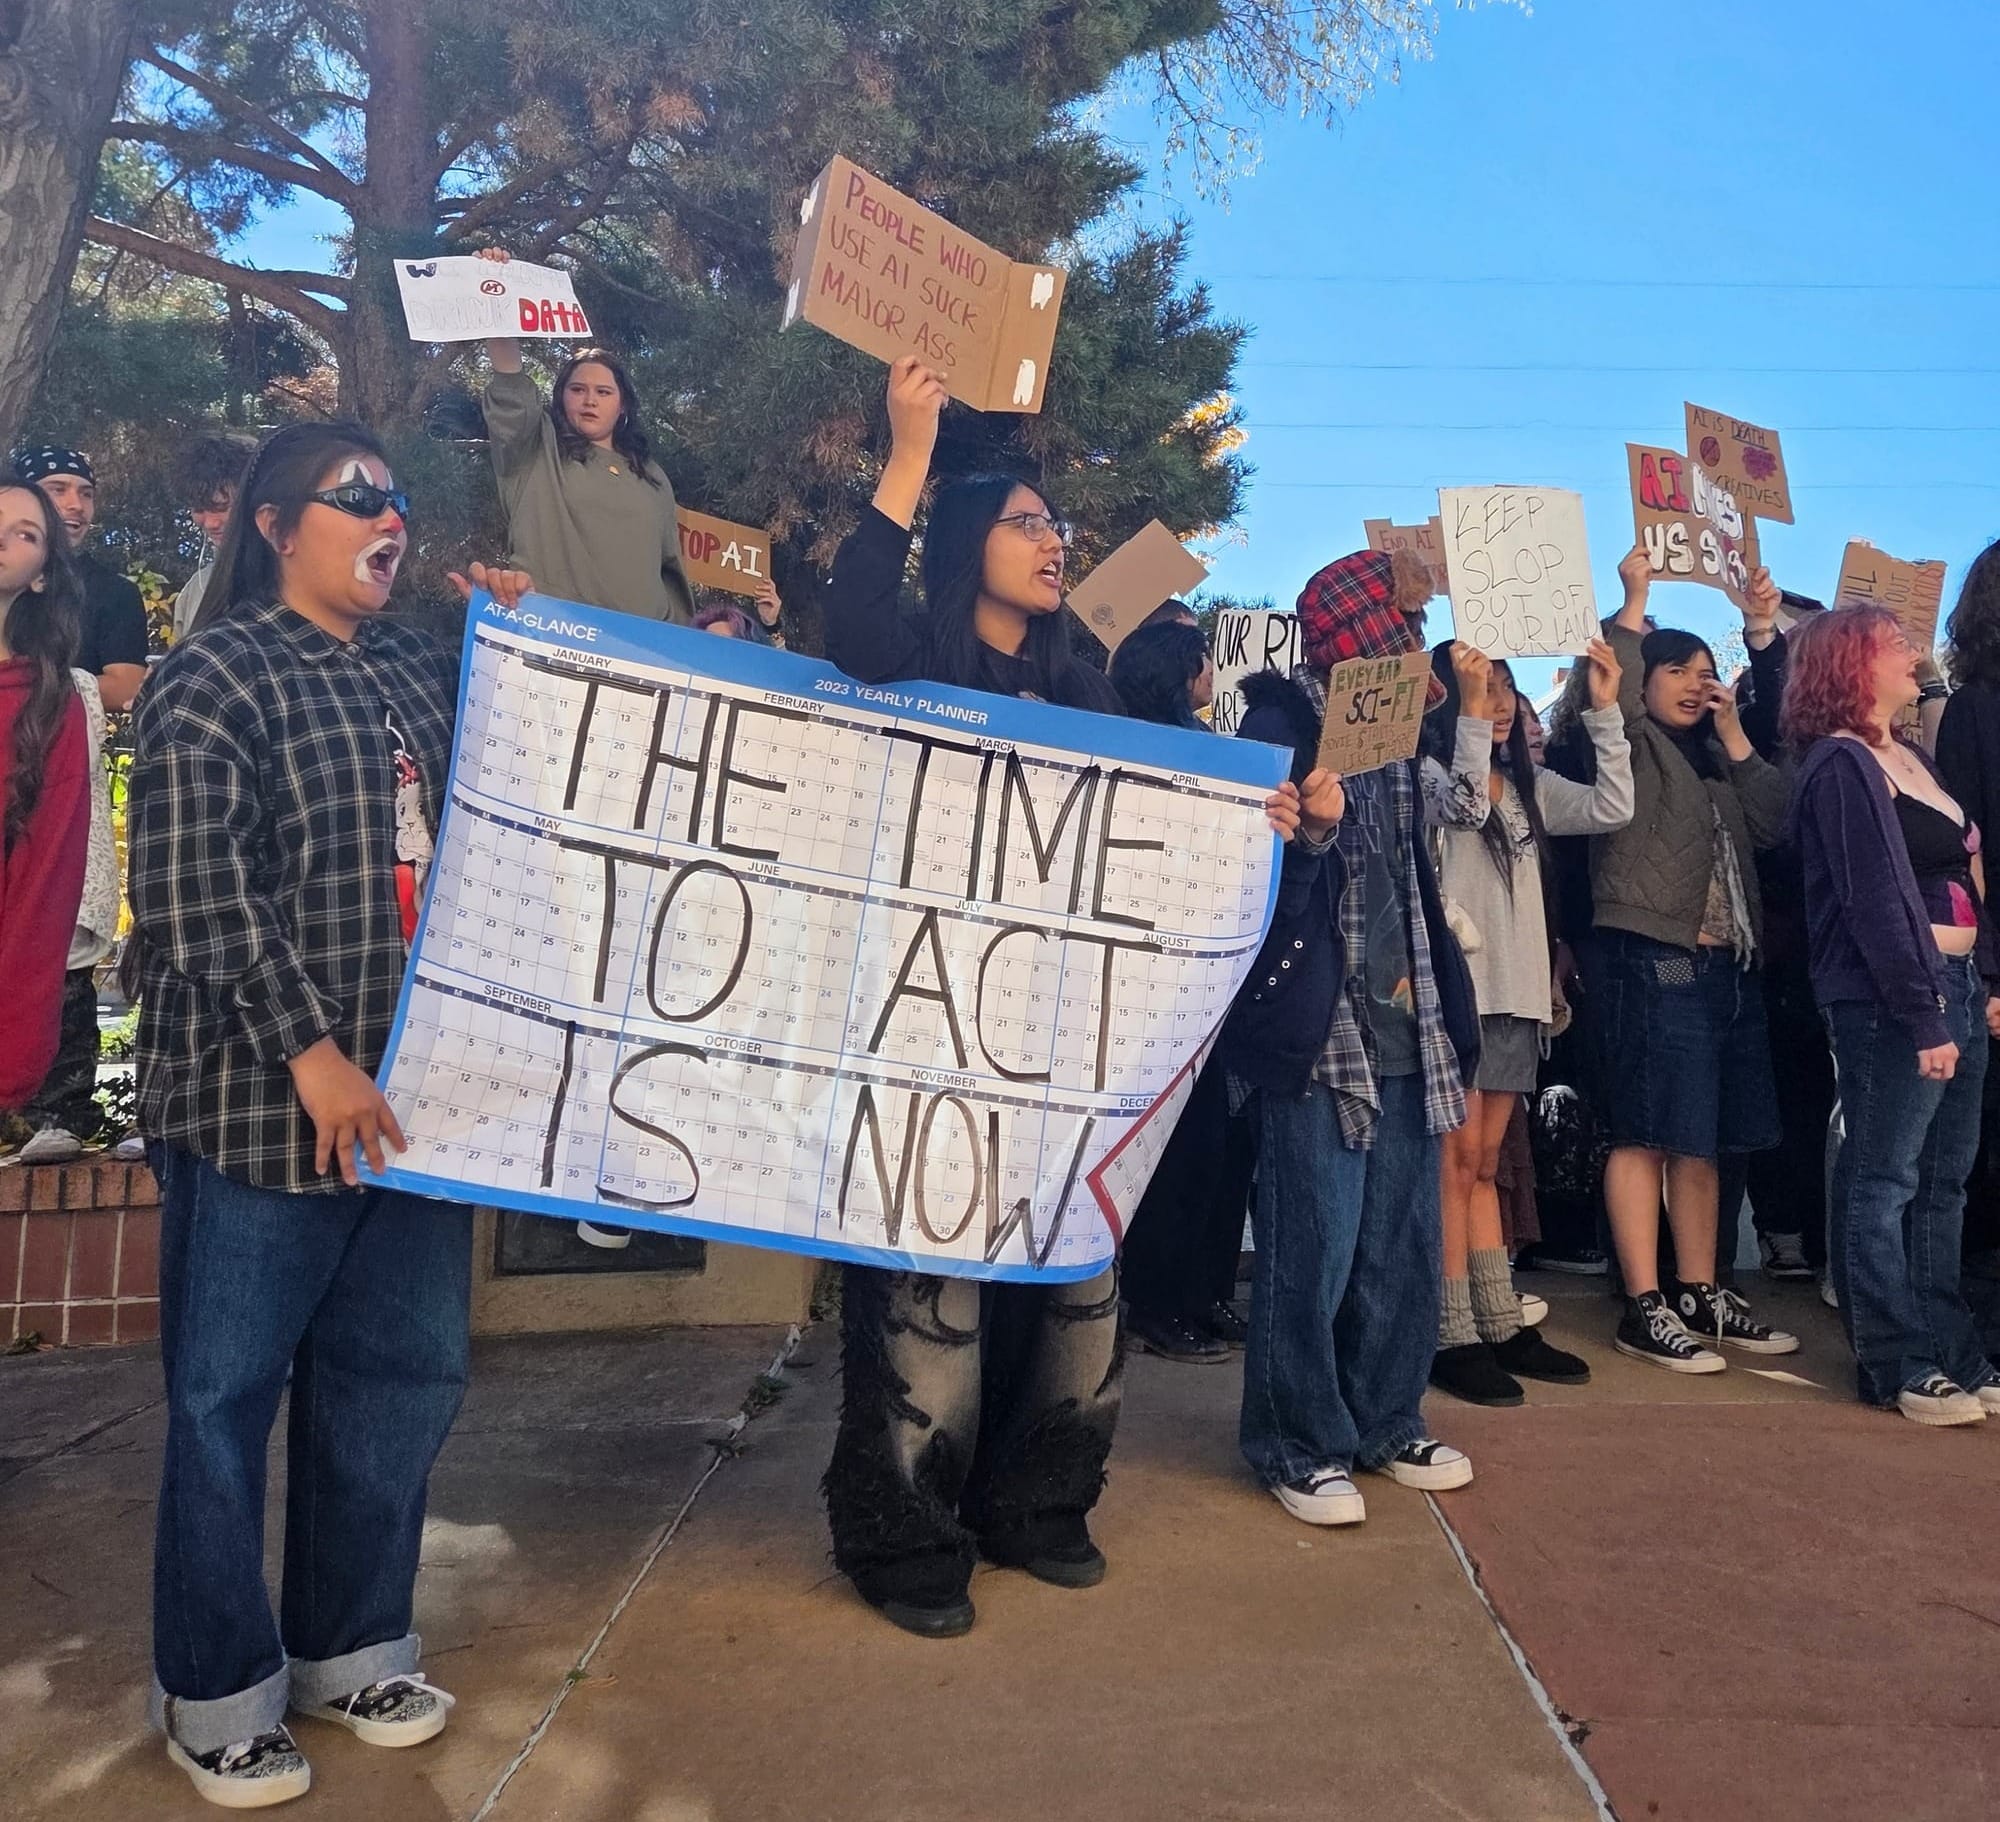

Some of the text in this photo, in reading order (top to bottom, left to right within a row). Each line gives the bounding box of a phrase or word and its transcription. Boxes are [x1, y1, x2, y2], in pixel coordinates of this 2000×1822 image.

[845, 171, 987, 287] PEOPLE WHO
[829, 214, 978, 334] USE AI SUCK
[820, 262, 957, 367] MAJOR ASS
[1692, 409, 1709, 427] AI
[1731, 421, 1766, 445] DEATH
[1640, 453, 1690, 513] AI
[1456, 493, 1545, 552] KEEP
[1415, 529, 1436, 550] AI
[1644, 522, 1695, 573] US
[720, 540, 764, 578] AI
[1462, 543, 1565, 595] SLOP
[1464, 584, 1585, 624] OUT OF
[1217, 613, 1251, 672] OUR
[552, 648, 612, 669] JANUARY
[763, 692, 825, 714] FEBRUARY
[814, 679, 989, 726] 2023 YEARLY PLANNER
[1345, 676, 1420, 725] SCI-FI
[621, 714, 631, 722] 13
[1213, 691, 1239, 733] ARE
[522, 720, 532, 728] 17
[975, 737, 1016, 752] MARCH
[486, 738, 619, 779] 23 24 25 27
[830, 757, 867, 771] 10 11
[481, 766, 521, 786] 30 31
[1033, 768, 1038, 776] 3
[1171, 773, 1201, 787] APRIL
[523, 657, 1175, 931] THE TIME
[826, 785, 835, 793] 17
[732, 796, 859, 828] 21 23 25
[942, 808, 950, 816] 14
[534, 816, 561, 832] MAY
[727, 825, 738, 833] 28
[881, 825, 1030, 860] 19 21 24
[1165, 849, 1227, 867] 12 14
[747, 862, 780, 876] JUNE
[932, 864, 1026, 888] 28 31
[555, 876, 564, 885] 11
[1187, 882, 1198, 890] 20
[492, 888, 560, 915] 16 17 18
[954, 900, 983, 913] JULY
[1130, 899, 1140, 908] 25
[1185, 909, 1195, 917] 27
[486, 918, 554, 946] 23 24 25
[832, 929, 841, 938] 10
[1142, 932, 1191, 949] AUGUST
[677, 932, 836, 968] 12 13 17
[510, 958, 520, 968] 31
[558, 836, 1163, 1095] TO ACT
[761, 979, 773, 988] 22
[916, 975, 925, 983] 11
[1031, 994, 1040, 1002] 15
[1179, 986, 1189, 994] 10
[483, 984, 552, 1014] SEPTEMBER
[756, 1010, 796, 1023] 29 30
[997, 1019, 1037, 1032] 21 22
[468, 1038, 474, 1047] 5
[704, 1034, 762, 1054] OCTOBER
[906, 1035, 1004, 1058] 25 28
[1115, 1037, 1126, 1046] 22
[1144, 1040, 1155, 1048] 23
[461, 1073, 528, 1098] 12 13 14
[910, 1068, 977, 1090] NOVEMBER
[681, 1088, 782, 1112] 10 11 13
[476, 1114, 489, 1125] 20
[1015, 1108, 1021, 1116] 4
[738, 1130, 807, 1149] 19 21
[952, 1130, 958, 1139] 9
[540, 1020, 1097, 1270] IS NOW
[468, 1150, 514, 1167] 27 28
[603, 1174, 615, 1184] 29
[762, 1167, 773, 1176] 27
[949, 1162, 1019, 1179] 16 18
[1041, 1174, 1052, 1183] 10
[826, 1177, 836, 1185] 19
[1039, 1205, 1048, 1214] 17
[820, 1210, 950, 1235] 26 30
[1063, 1237, 1074, 1246] 25
